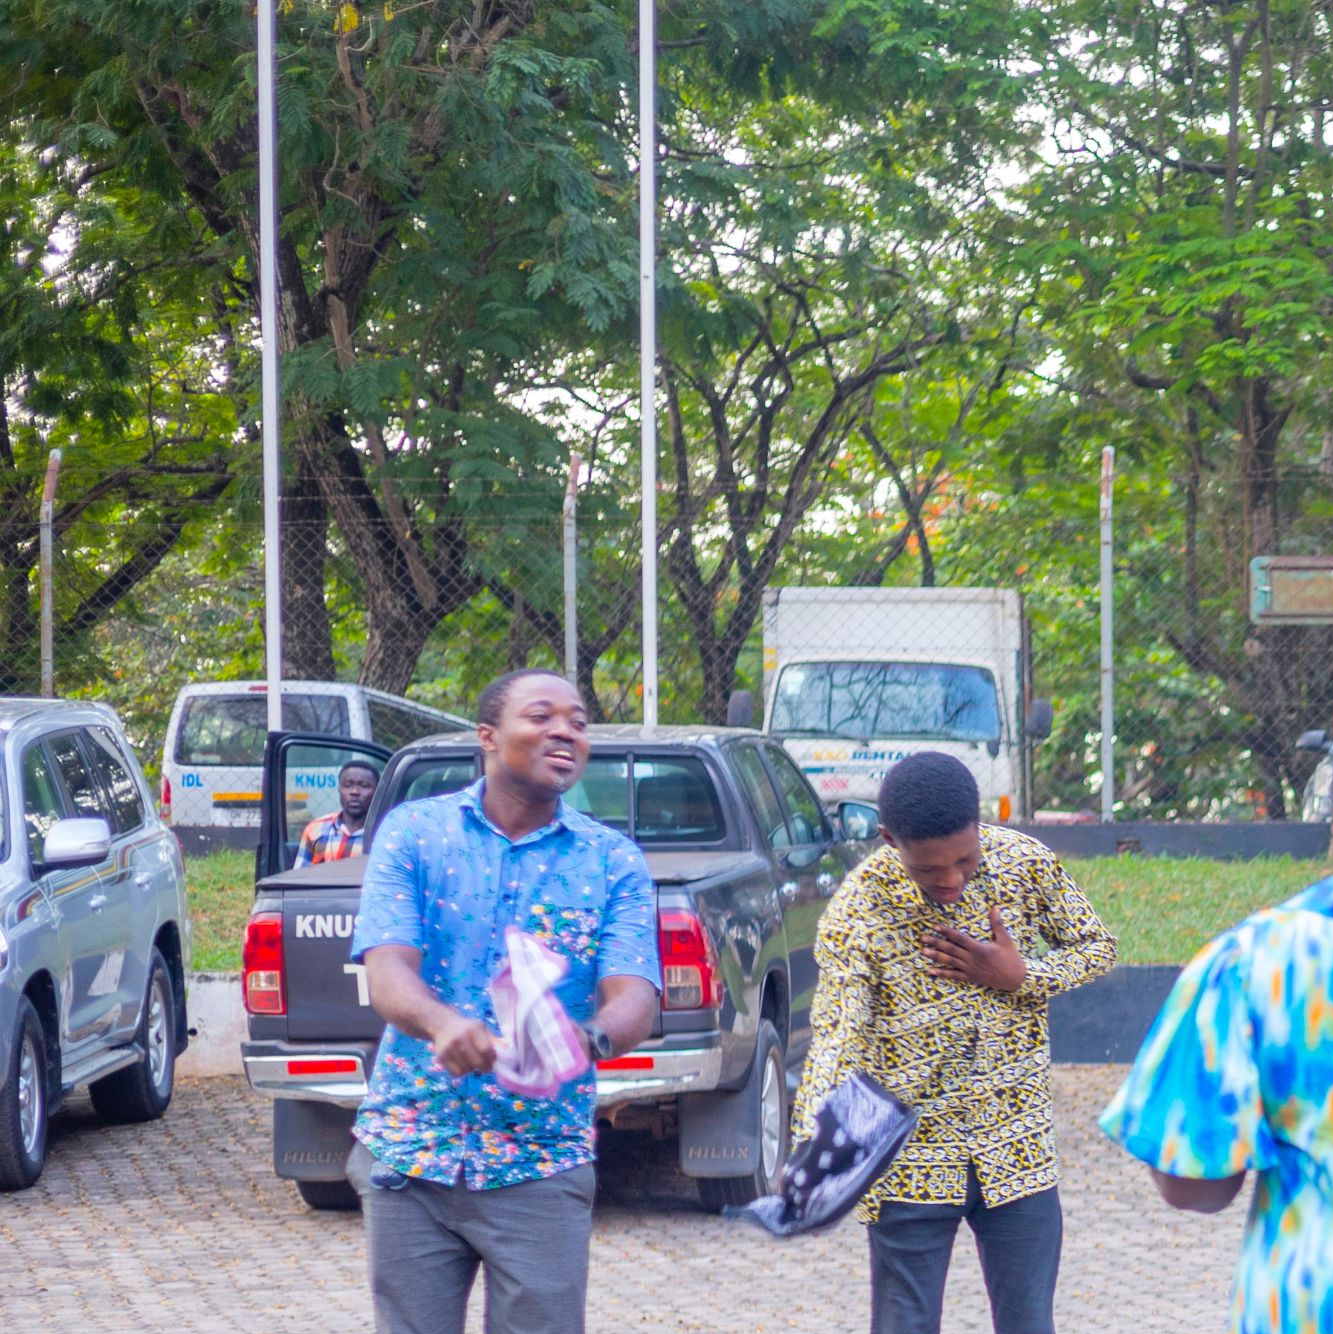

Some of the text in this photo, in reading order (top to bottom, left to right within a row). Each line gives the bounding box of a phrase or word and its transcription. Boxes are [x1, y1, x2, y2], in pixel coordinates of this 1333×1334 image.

[181, 773, 204, 788] IDL
[283, 1151, 344, 1163] HILUX
[688, 1146, 749, 1160] HILUX
